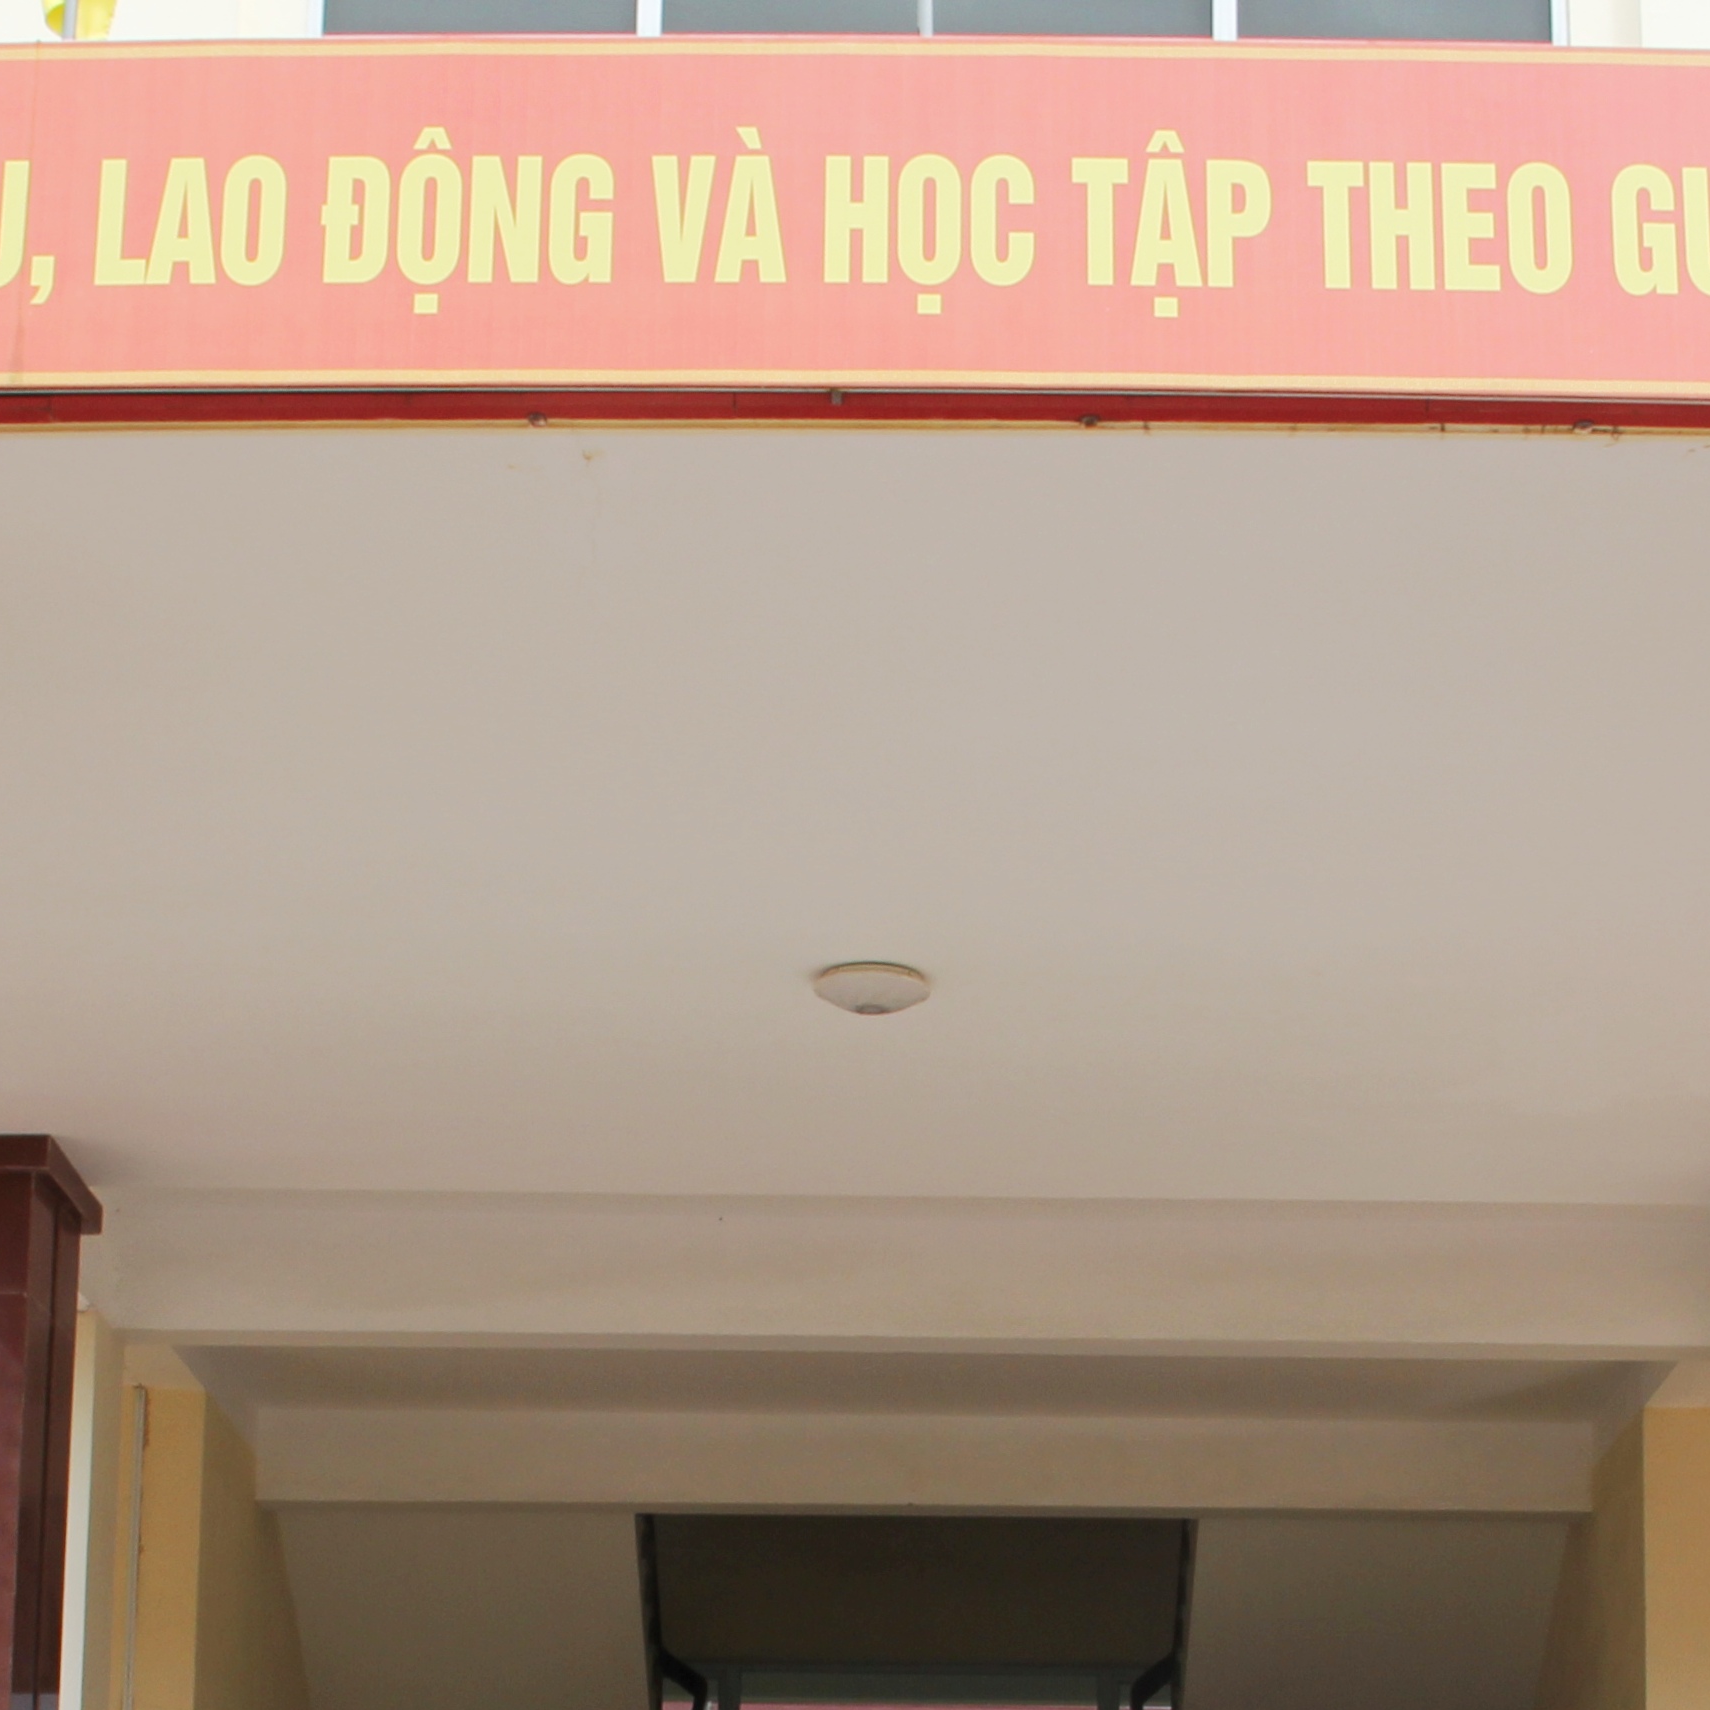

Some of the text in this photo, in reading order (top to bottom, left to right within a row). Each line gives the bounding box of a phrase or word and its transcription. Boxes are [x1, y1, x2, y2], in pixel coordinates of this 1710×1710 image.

[91, 152, 290, 288] LAO
[319, 125, 618, 316] ĐỘNG
[650, 124, 790, 285] VÀ
[822, 152, 1038, 316] HỌC
[1070, 127, 1274, 319] TẬP
[1306, 158, 1575, 294] THEO
